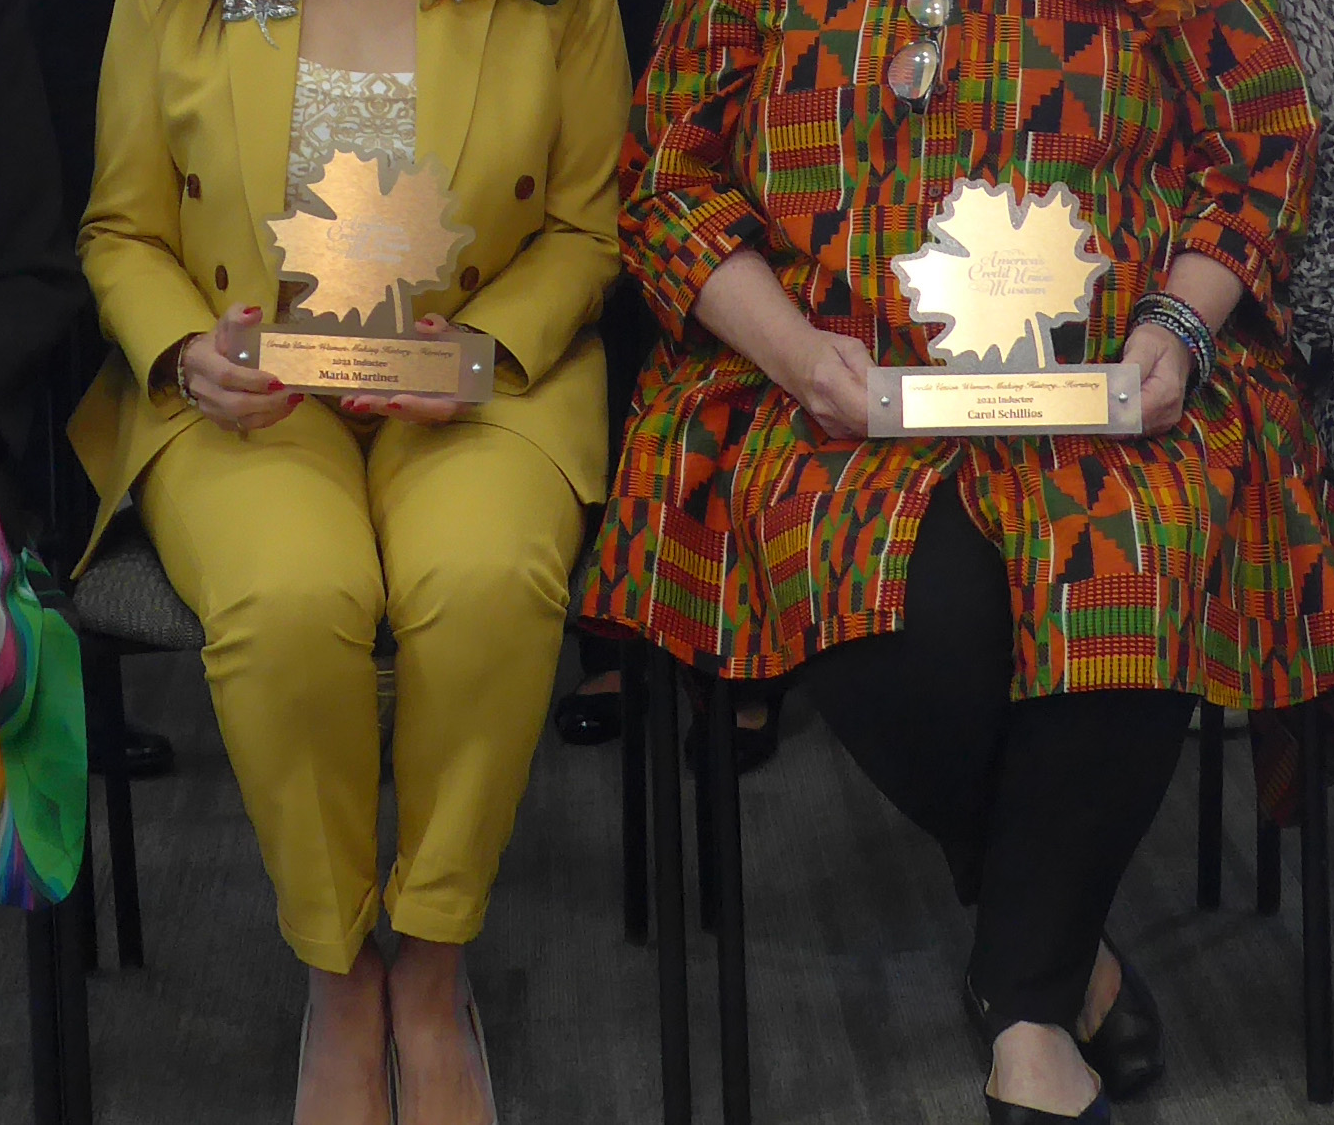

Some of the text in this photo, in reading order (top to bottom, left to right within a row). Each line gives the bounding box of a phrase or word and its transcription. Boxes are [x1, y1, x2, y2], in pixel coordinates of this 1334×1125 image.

[352, 358, 389, 367] Inductee
[318, 369, 399, 383] Maria Martinez
[998, 395, 1034, 404] Inductee
[967, 407, 1043, 420] Carol Schillios
